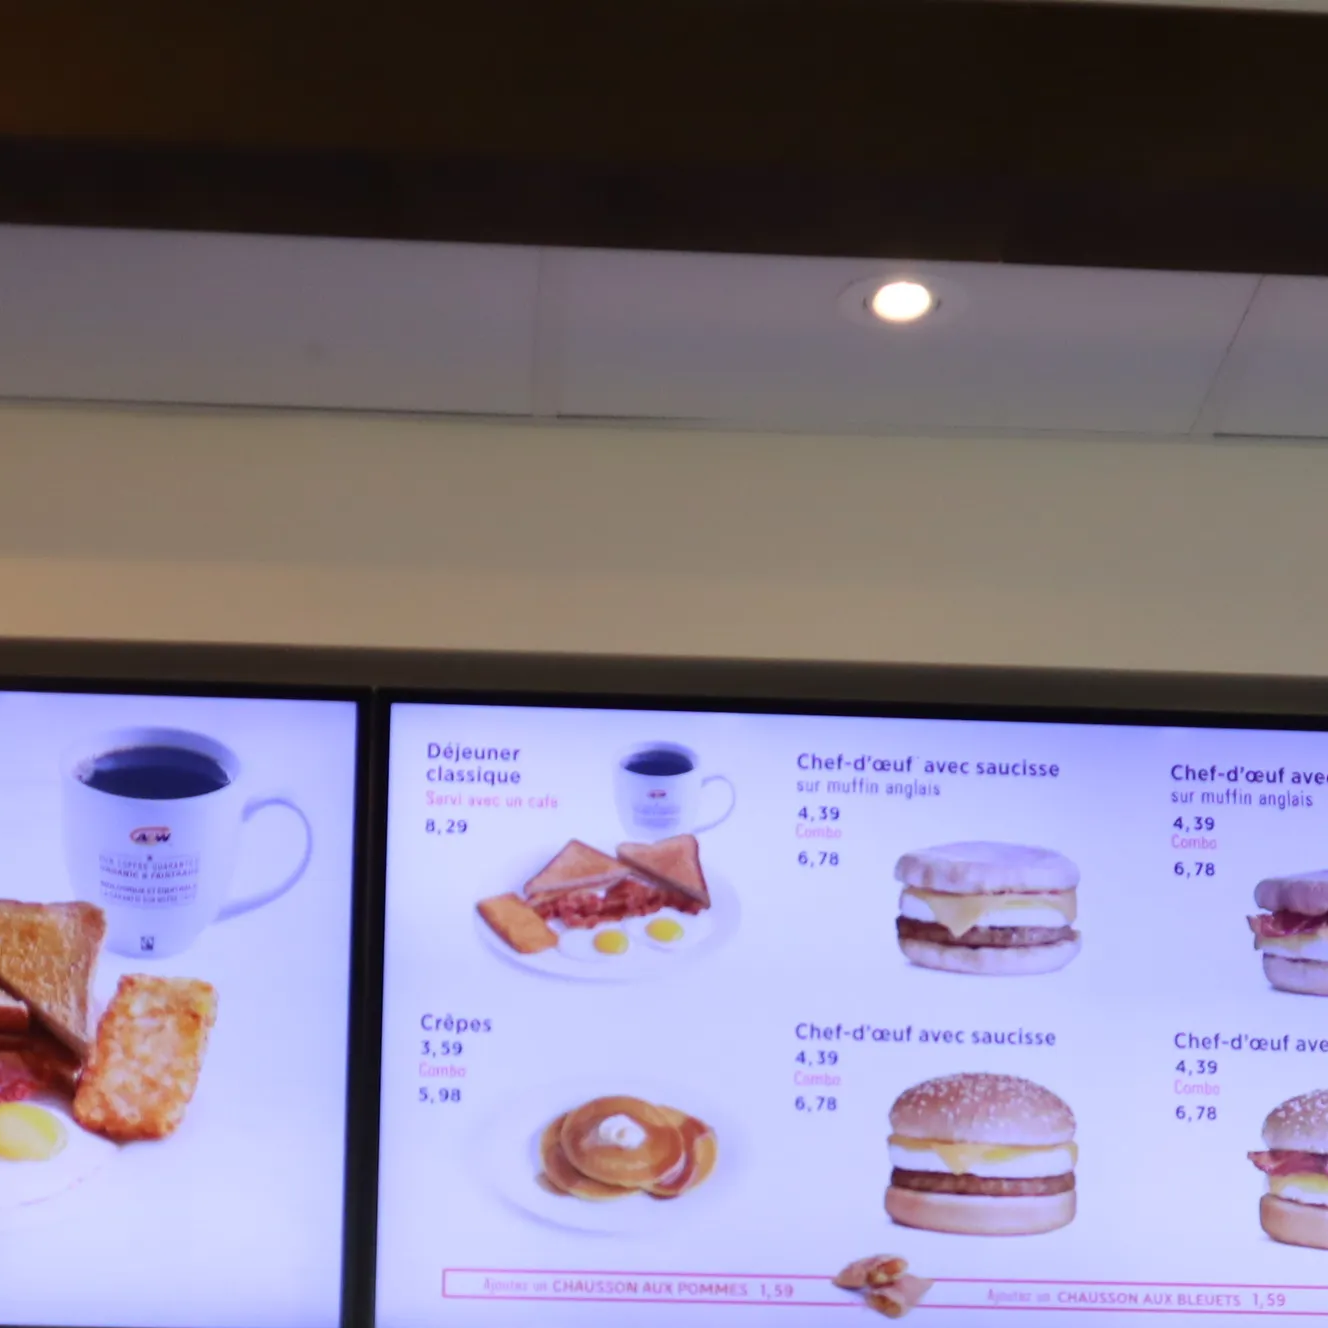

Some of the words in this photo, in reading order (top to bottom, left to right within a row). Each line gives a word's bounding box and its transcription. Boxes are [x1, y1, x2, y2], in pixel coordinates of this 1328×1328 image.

[427, 742, 520, 763] Déjeuner
[426, 765, 520, 786] classique
[924, 760, 969, 774] avec
[976, 759, 1060, 777] saucisse
[797, 781, 820, 793] sur
[827, 778, 879, 794] muffin
[886, 780, 941, 799] anglais
[1171, 790, 1194, 803] sur
[1201, 789, 1252, 805] muffin
[1259, 790, 1313, 810] anglais
[798, 806, 840, 822] 4,39
[425, 819, 467, 835] 8,29
[1173, 816, 1215, 832] 4,39
[798, 852, 839, 868] 6,78
[1174, 862, 1215, 878] 6,78
[420, 1014, 492, 1034] Crêpes
[919, 1030, 964, 1044] avec
[972, 1028, 1056, 1046] saucisse
[795, 1051, 839, 1067] 4,39
[1175, 1060, 1218, 1076] 4,39
[795, 1097, 837, 1112] 6,78
[1175, 1106, 1217, 1122] 6,78
[553, 1280, 638, 1295] CHAUSSON
[643, 1282, 672, 1295] AUX
[678, 1282, 747, 1297] POMMES
[1057, 1290, 1138, 1305] CHAUSSON
[1143, 1293, 1172, 1306] AUX
[1178, 1293, 1241, 1307] BLEUETS
